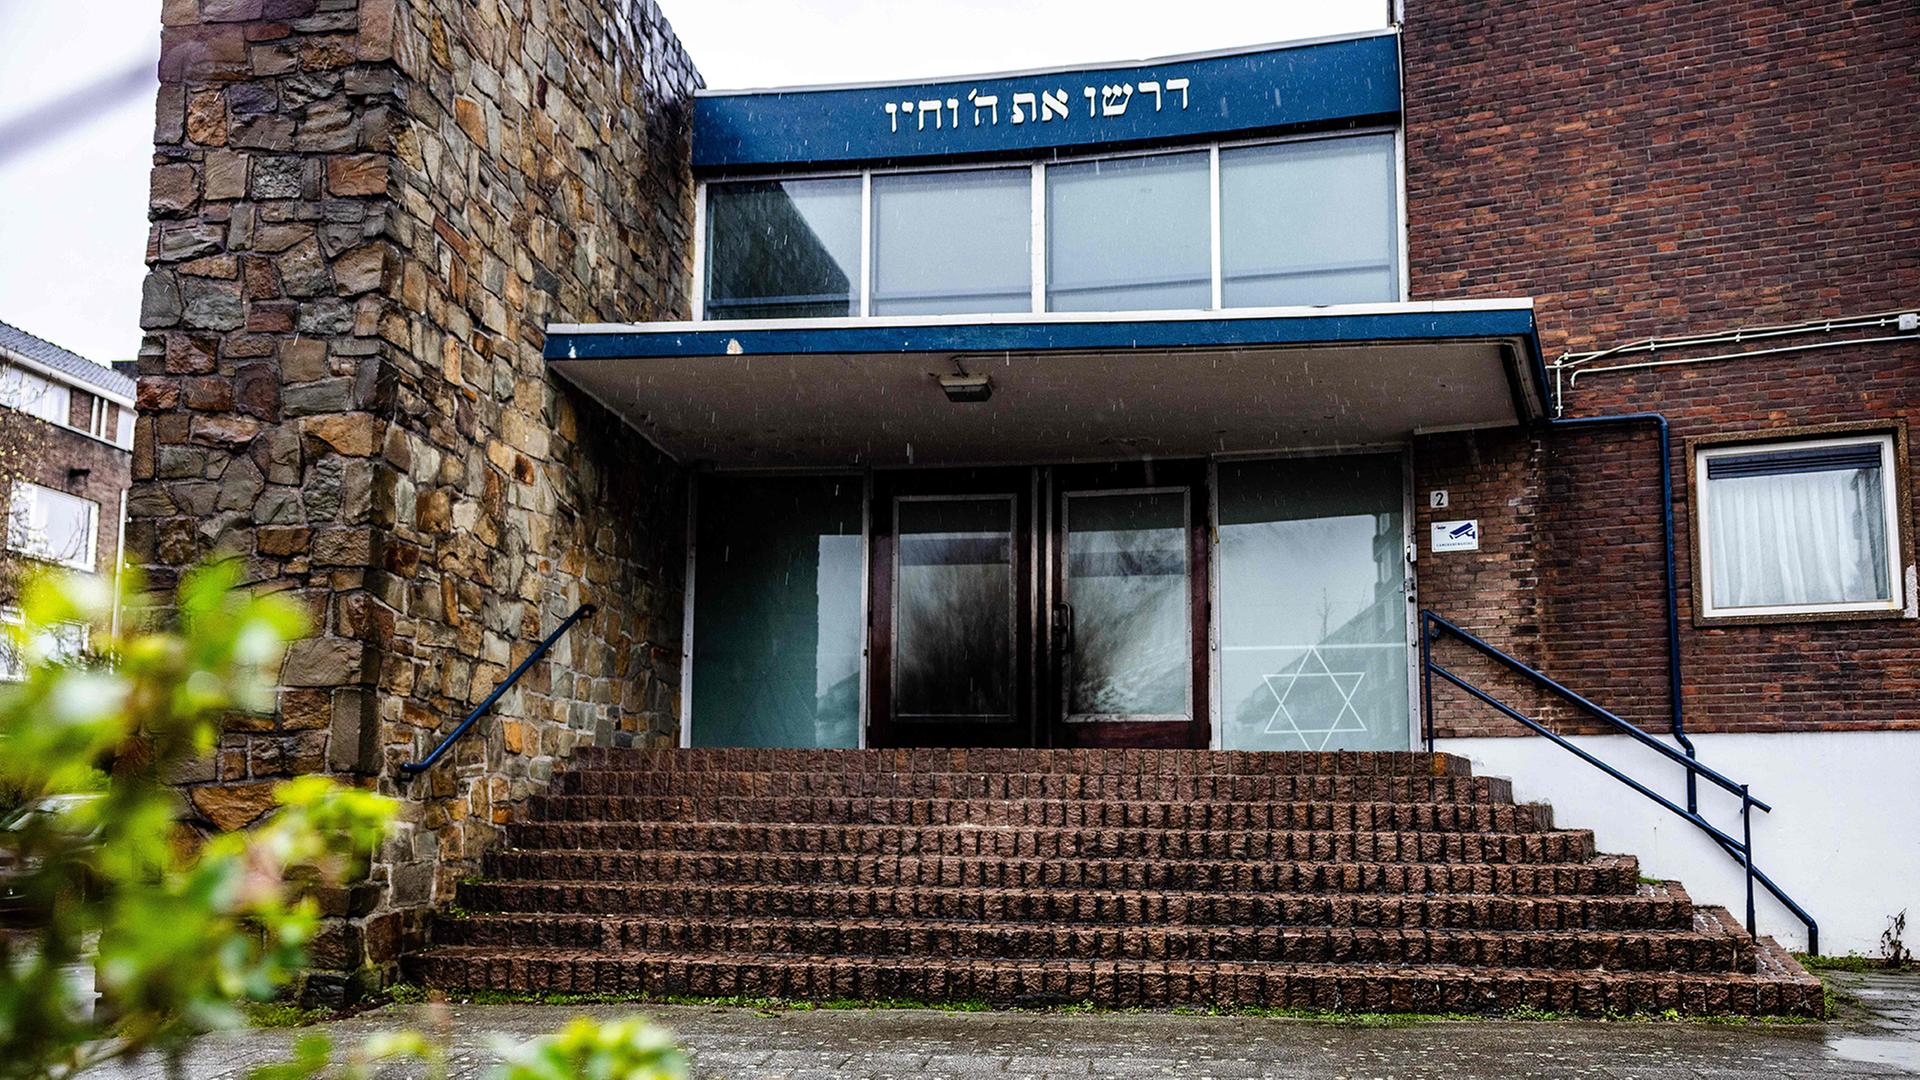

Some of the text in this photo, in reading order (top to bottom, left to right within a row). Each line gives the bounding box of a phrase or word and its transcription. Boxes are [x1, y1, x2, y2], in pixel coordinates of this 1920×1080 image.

[1011, 88, 1070, 124] את
[1083, 78, 1190, 117] דרשו
[885, 98, 959, 133] וחיו
[1436, 492, 1444, 505] 2
